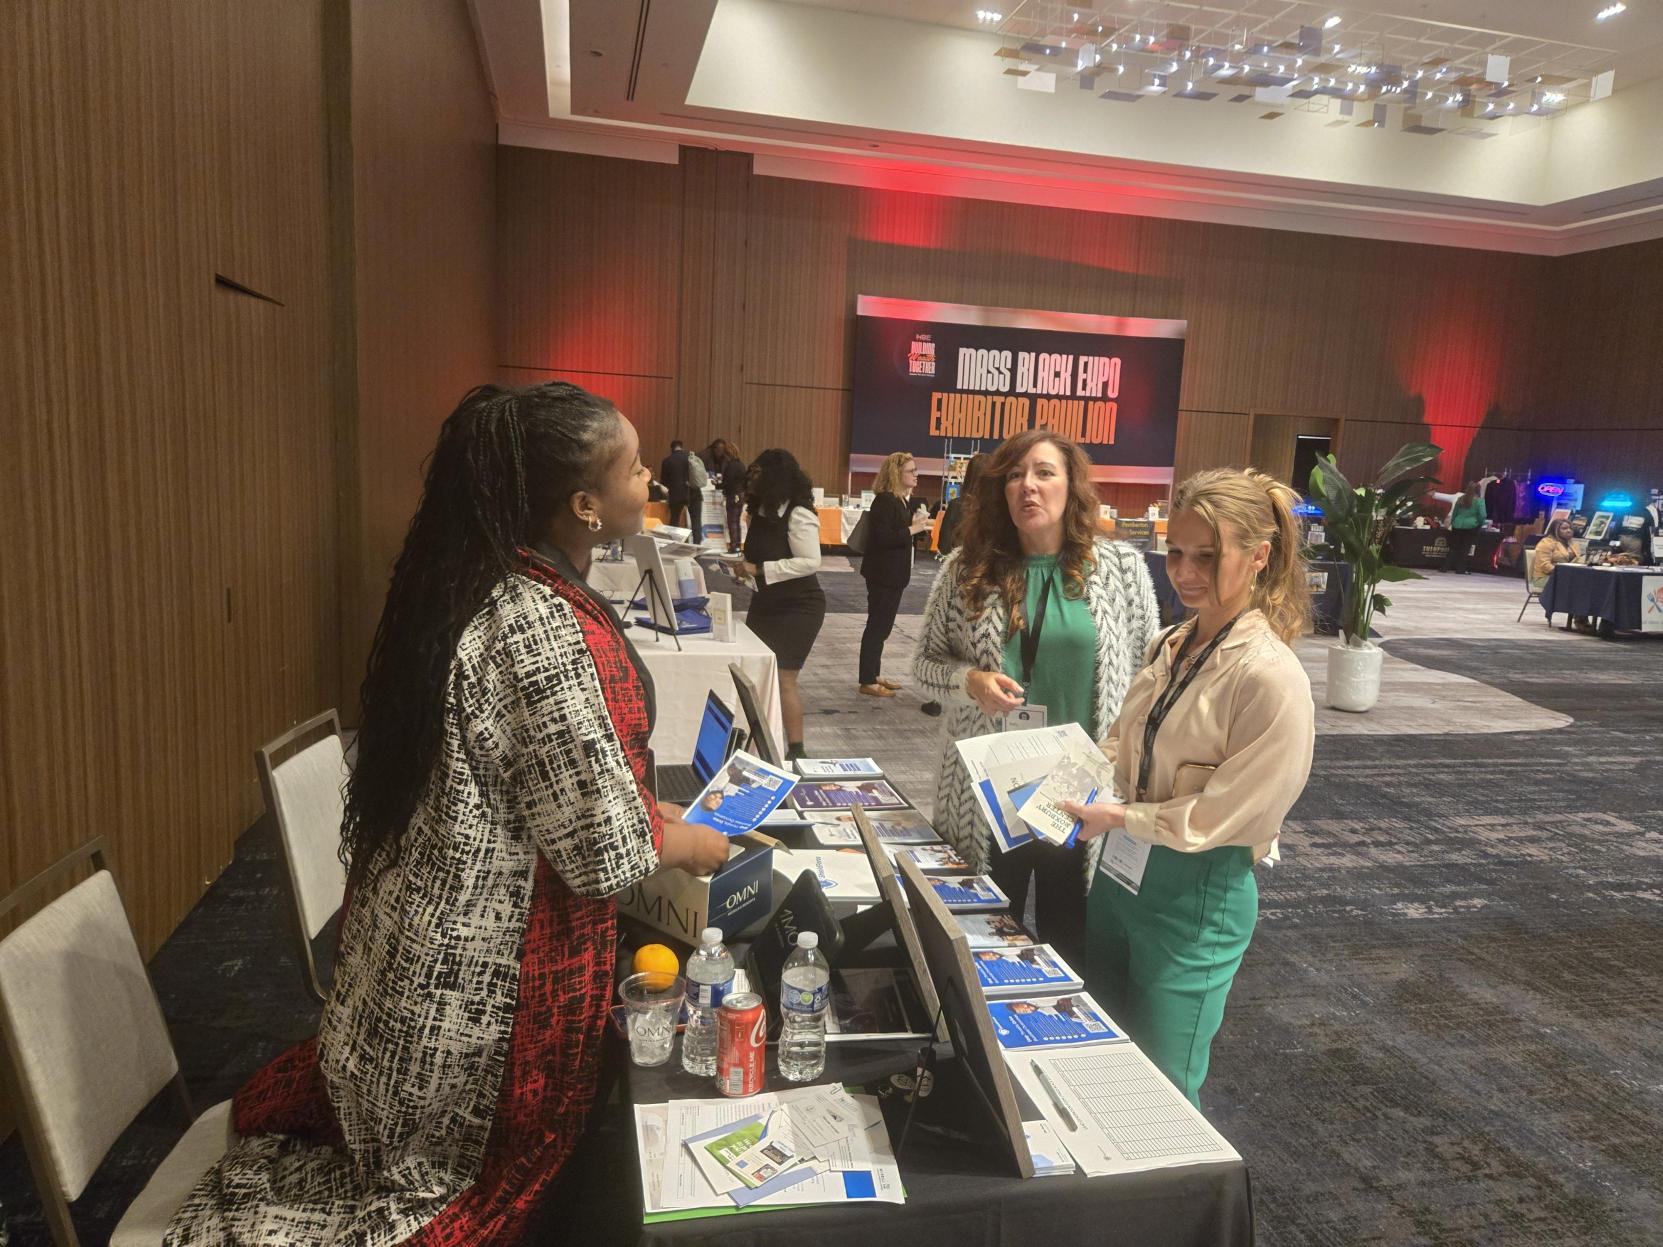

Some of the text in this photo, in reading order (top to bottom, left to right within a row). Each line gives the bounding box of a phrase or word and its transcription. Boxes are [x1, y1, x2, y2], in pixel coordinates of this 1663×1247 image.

[909, 361, 936, 374] TOGETHER
[956, 347, 1121, 398] MASS BLACK EXPO
[929, 392, 1119, 445] EXHIBITOR PAVILION
[1538, 485, 1563, 494] OPEN
[1050, 821, 1066, 834] THE
[726, 880, 759, 909] OMNI
